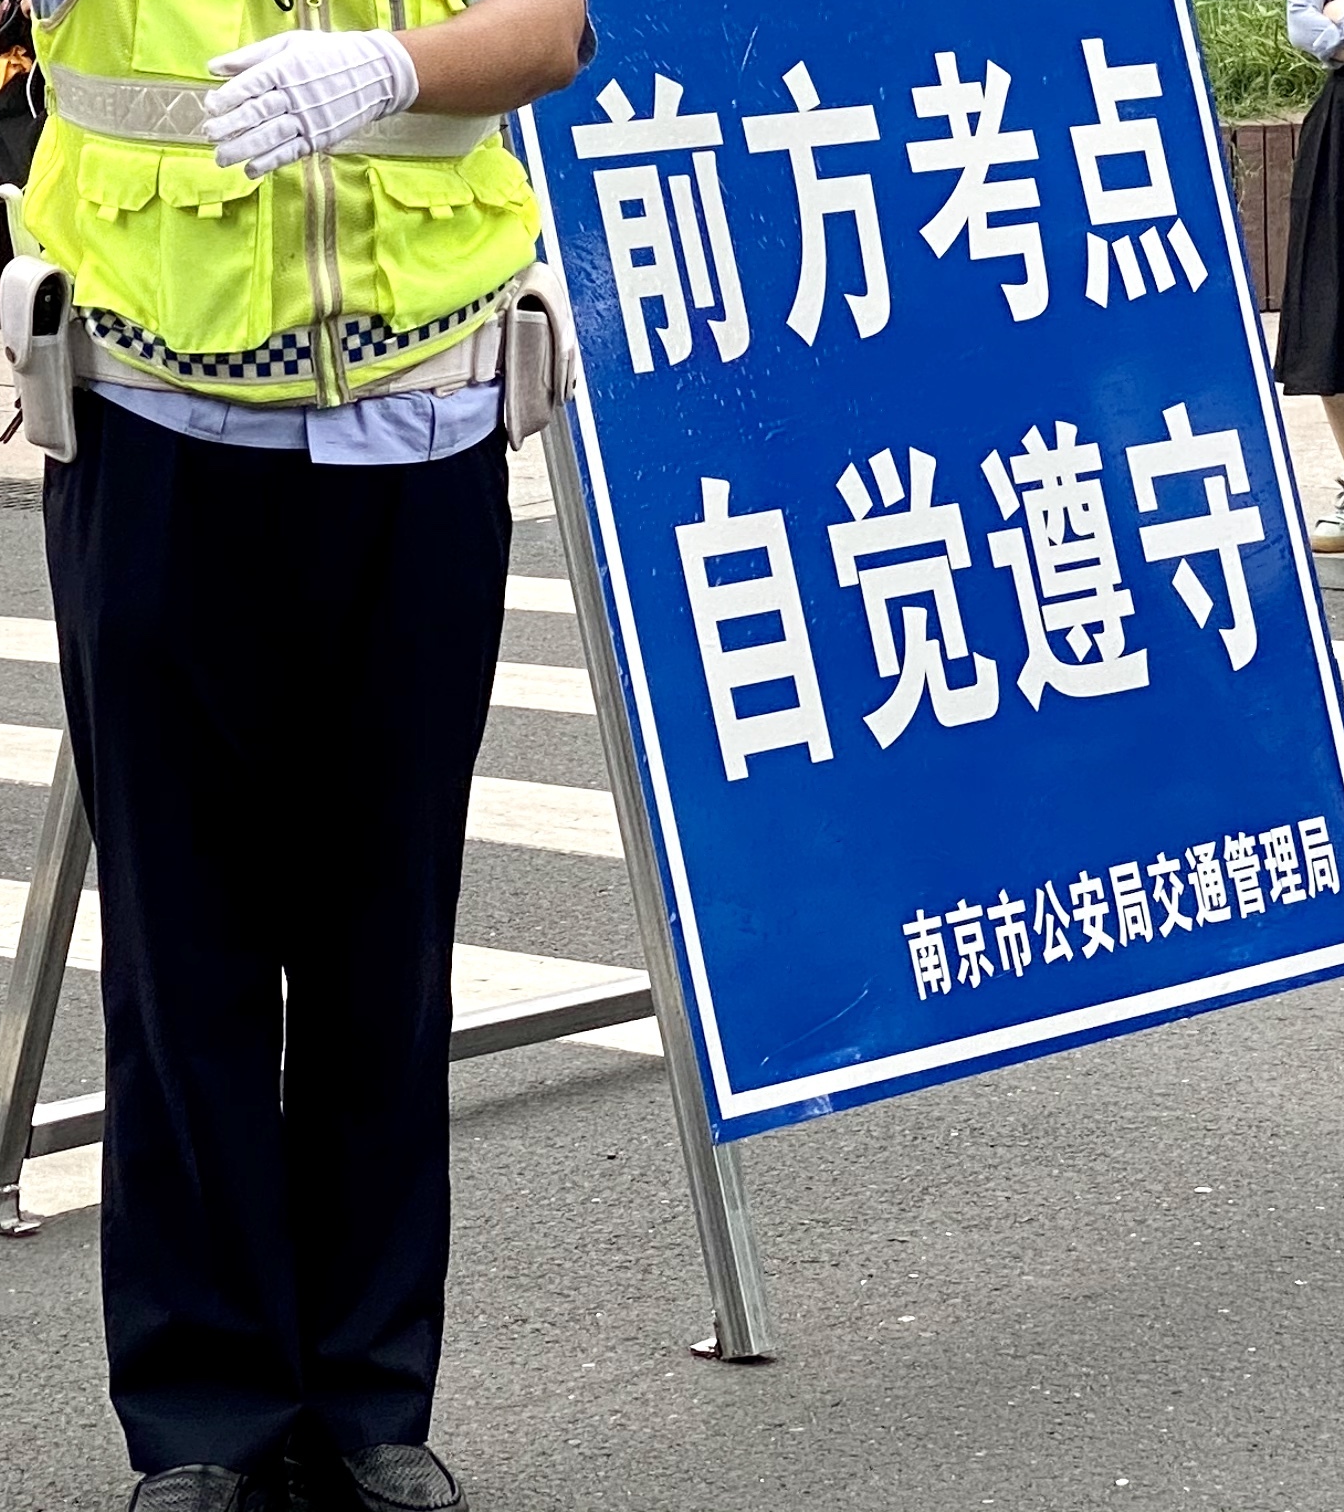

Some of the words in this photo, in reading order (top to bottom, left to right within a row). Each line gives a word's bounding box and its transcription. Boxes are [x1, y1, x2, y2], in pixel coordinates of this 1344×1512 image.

[571, 37, 1209, 375] 前方考点
[675, 402, 1266, 781] 自觉遵守
[902, 815, 1341, 1001] 南京市公安局交通管理局
